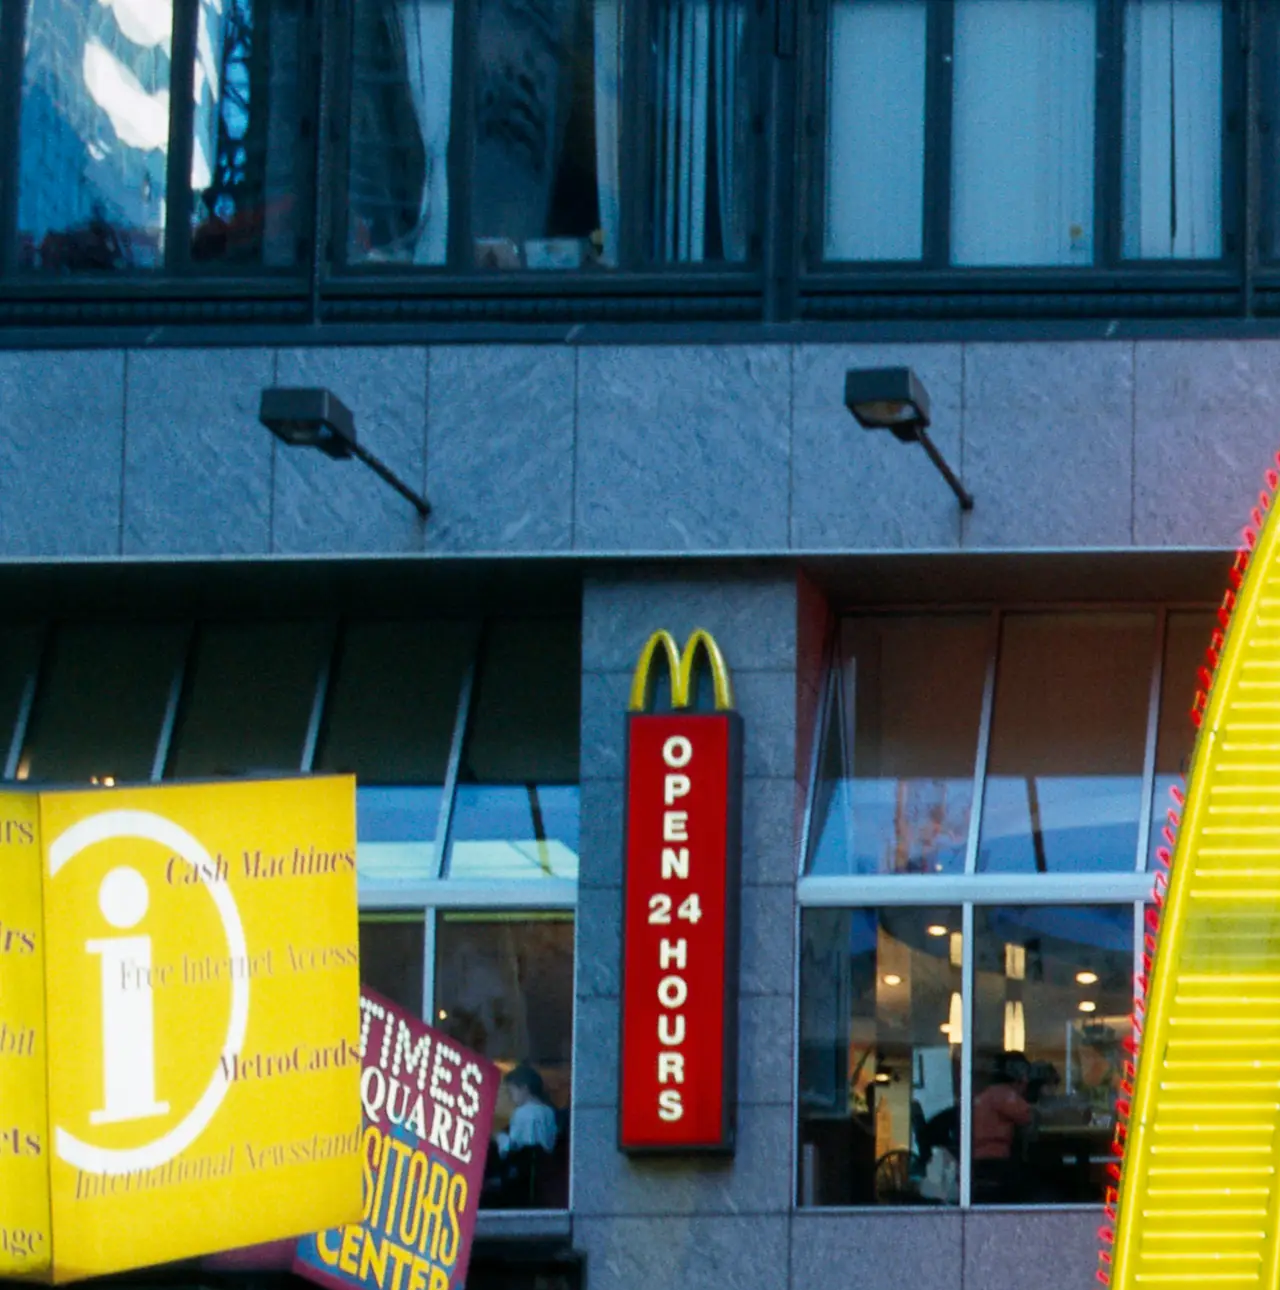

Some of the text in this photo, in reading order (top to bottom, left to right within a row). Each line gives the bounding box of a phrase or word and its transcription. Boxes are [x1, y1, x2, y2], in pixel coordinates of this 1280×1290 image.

[165, 845, 356, 886] Cash Machines
[119, 942, 358, 992] Free Internet Access
[647, 735, 702, 1122] OPEN 24 HOURS
[220, 1038, 361, 1082] MetroCards
[359, 995, 483, 1118] TIMES
[360, 1066, 475, 1164] QUARE
[75, 1123, 361, 1200] International Newsstand
[363, 1124, 468, 1266] SITORS
